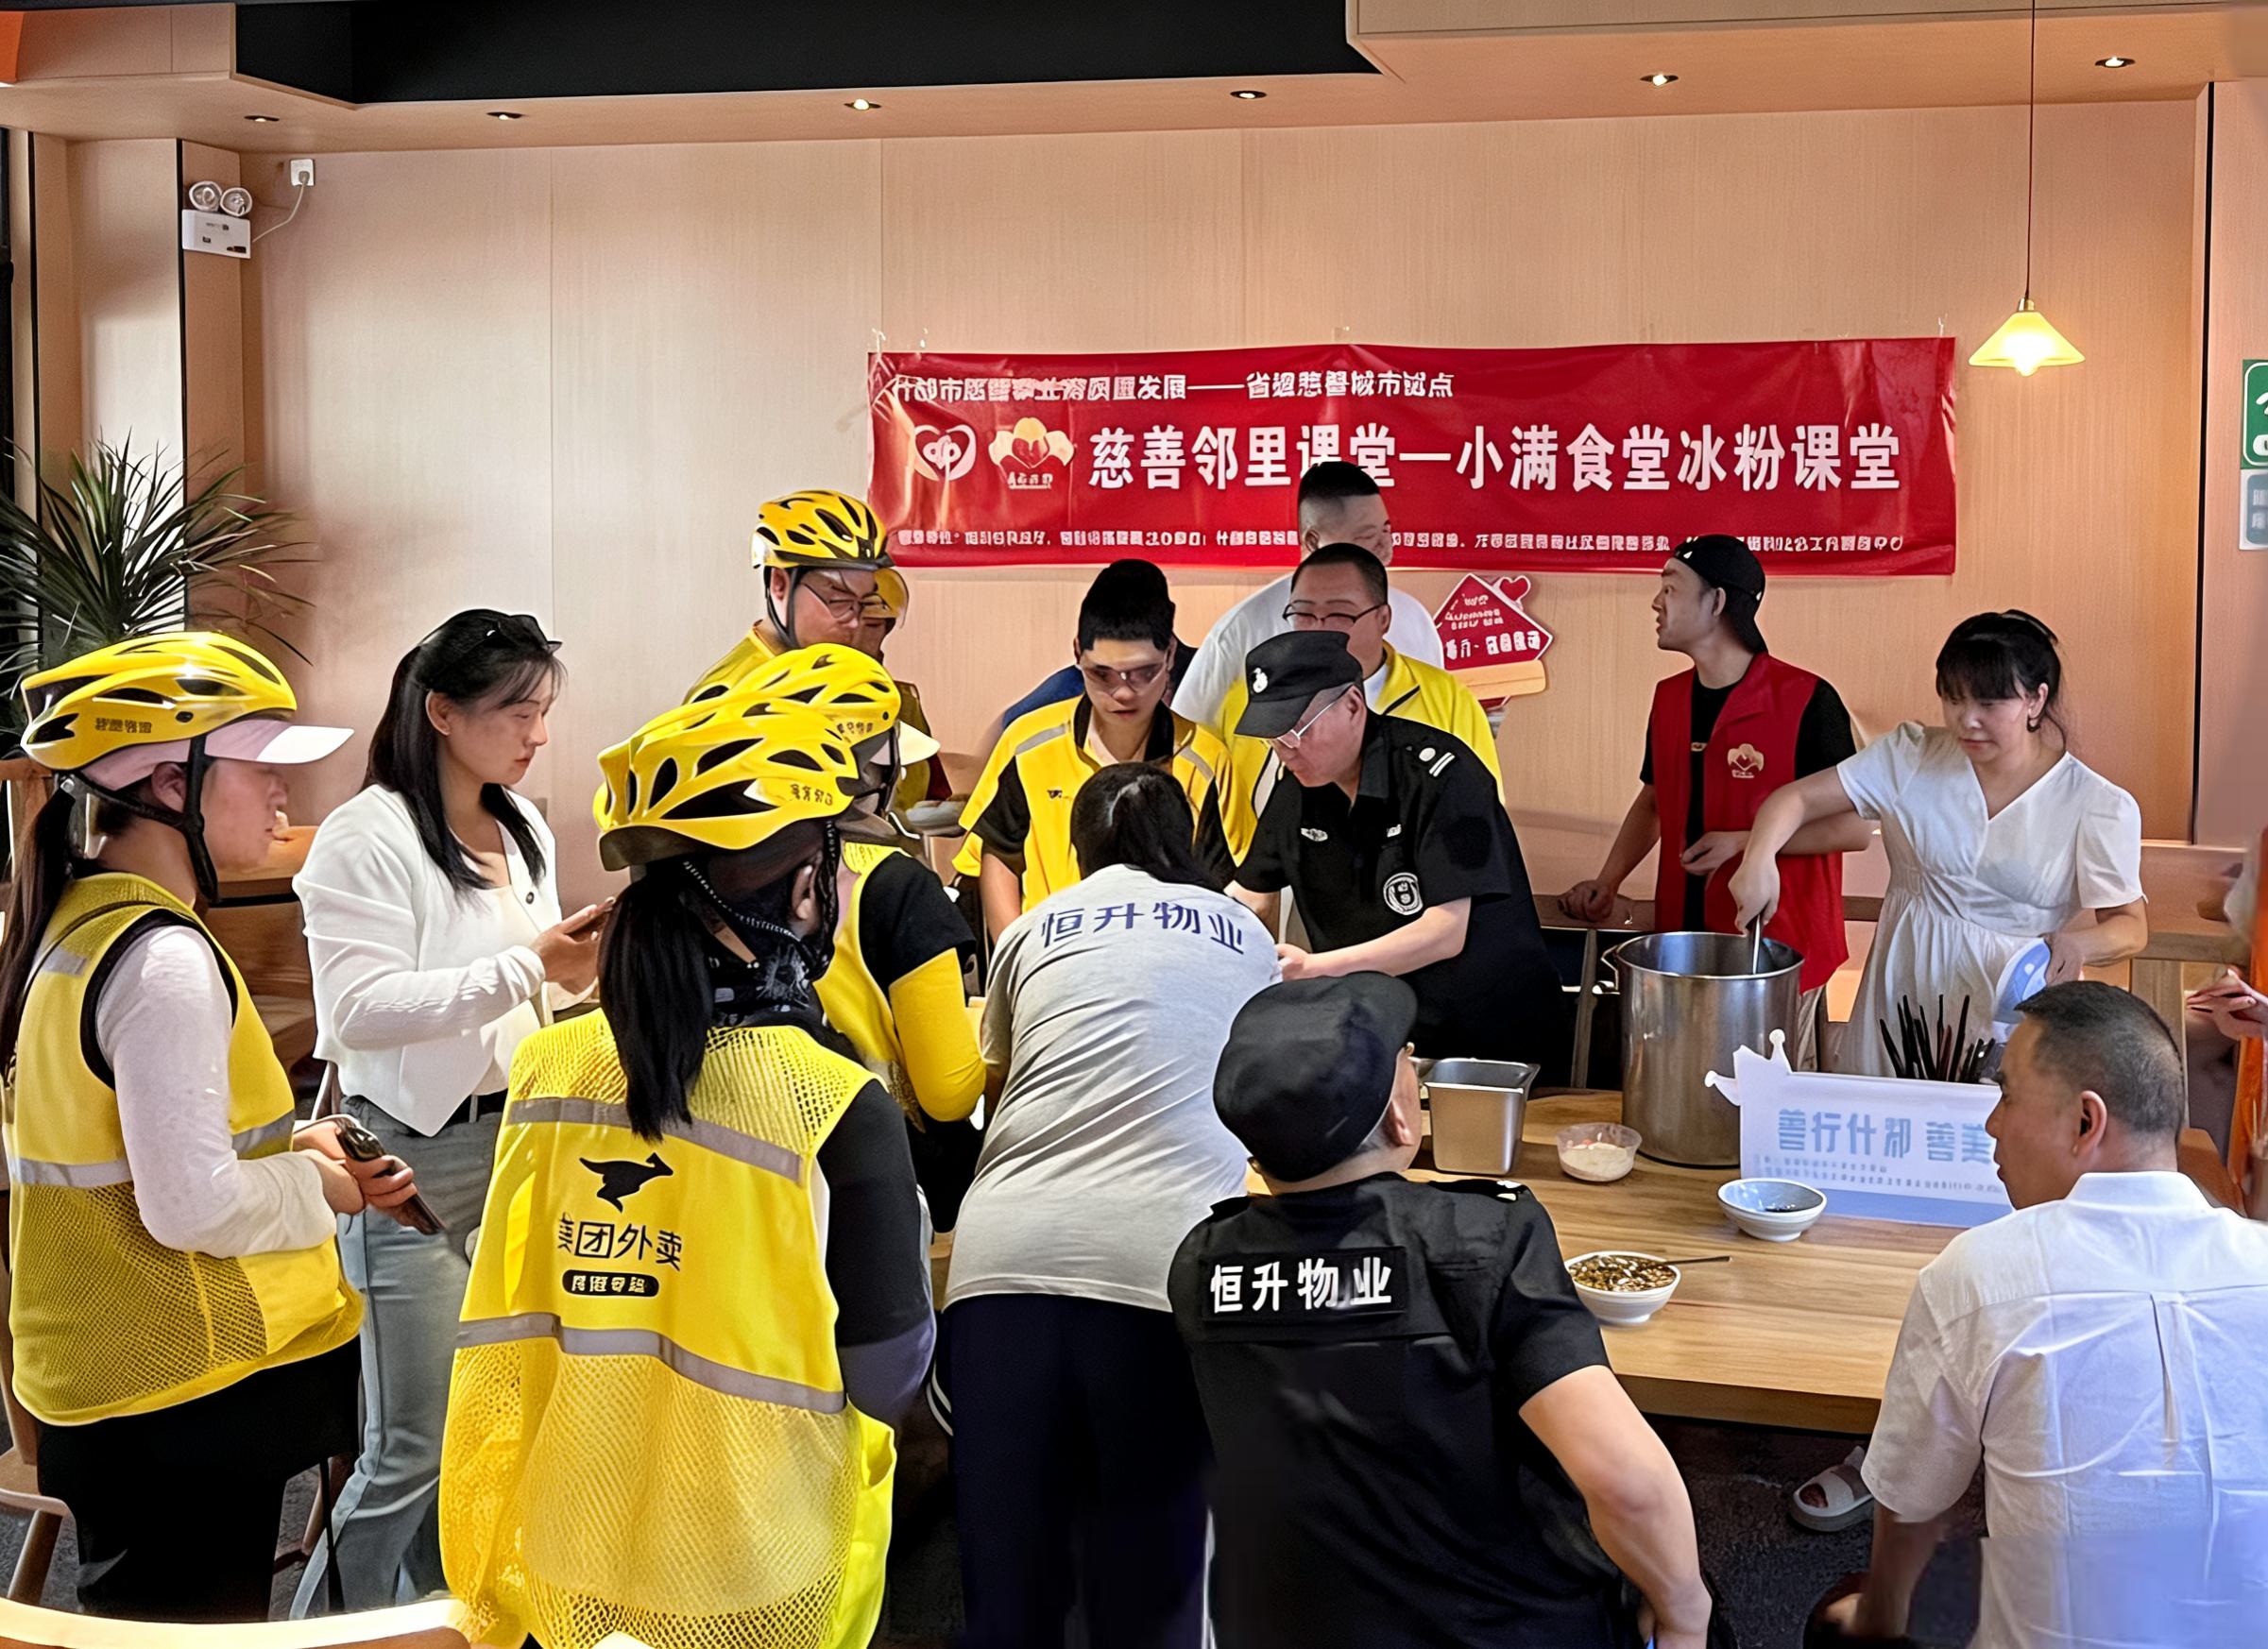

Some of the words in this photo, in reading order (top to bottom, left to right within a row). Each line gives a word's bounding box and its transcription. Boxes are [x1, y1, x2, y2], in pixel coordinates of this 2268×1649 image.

[1040, 902, 1245, 955] 恒升物业
[558, 1212, 682, 1272] 美团外卖
[1210, 1257, 1392, 1314] 恒升物业
